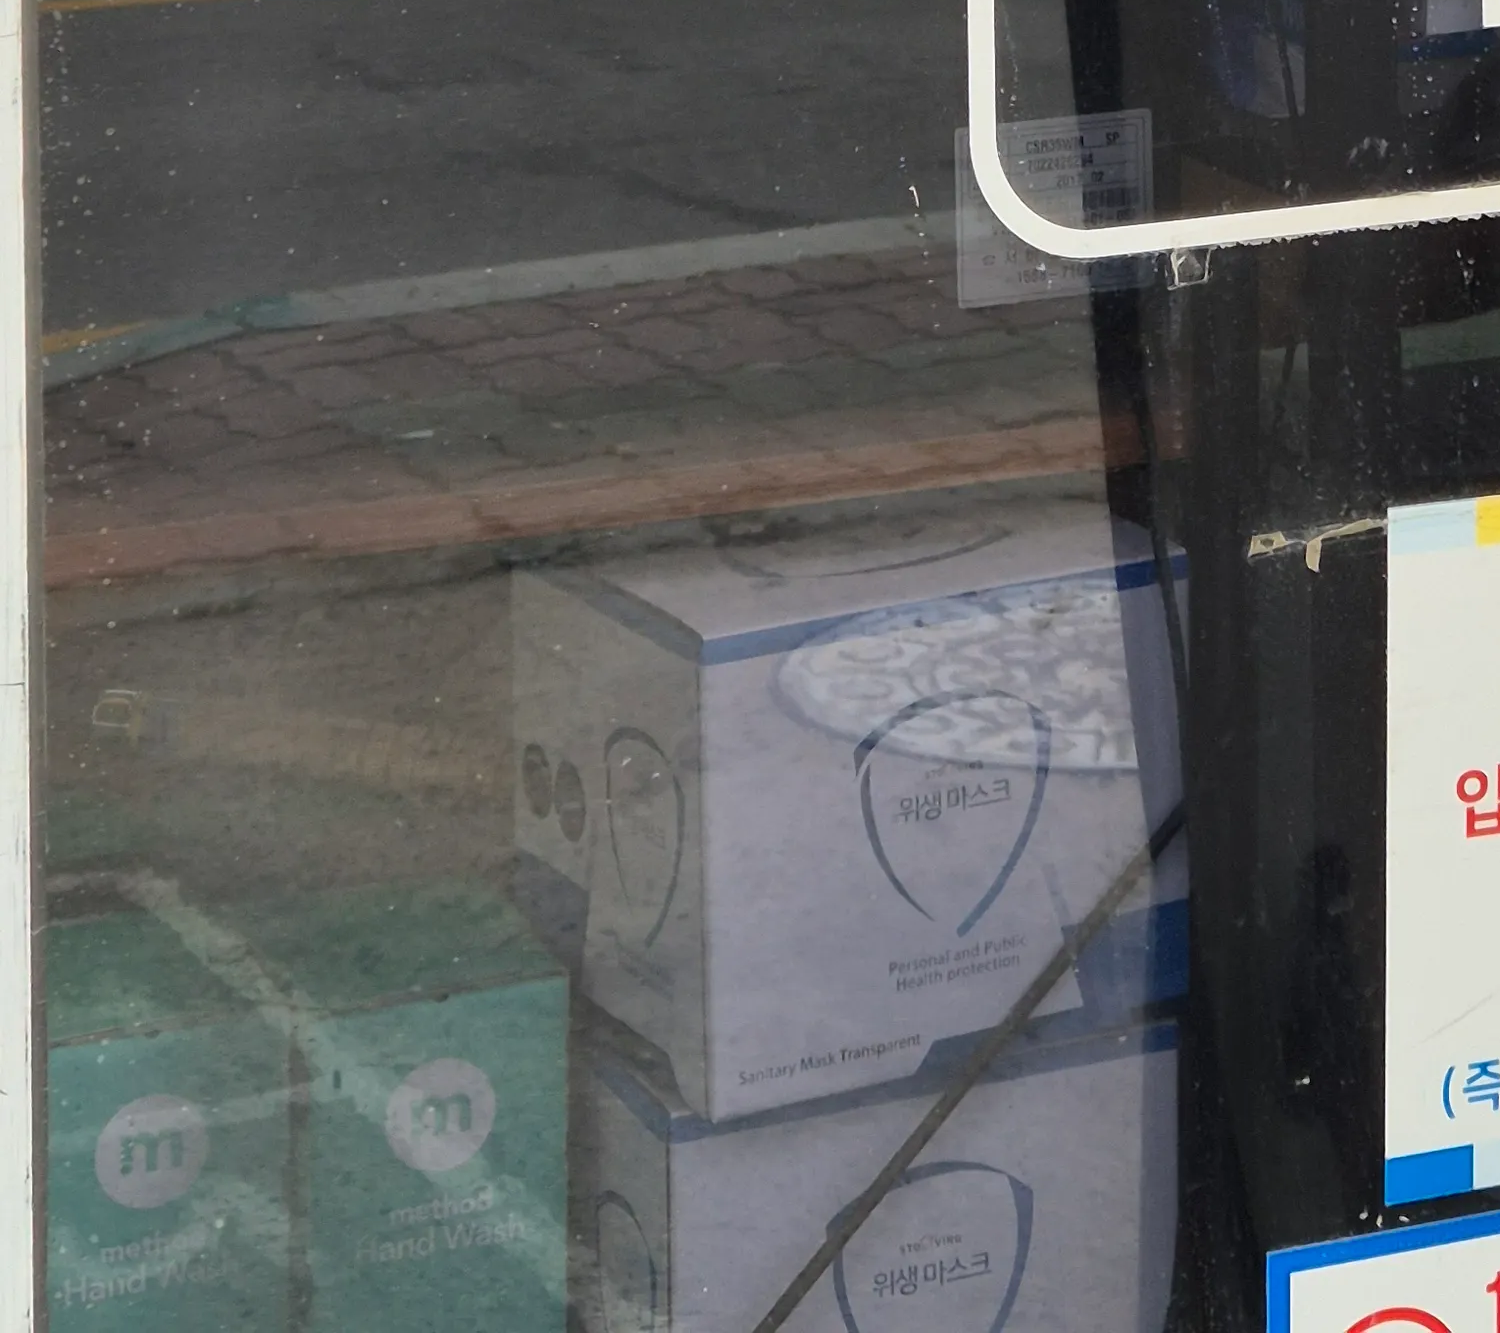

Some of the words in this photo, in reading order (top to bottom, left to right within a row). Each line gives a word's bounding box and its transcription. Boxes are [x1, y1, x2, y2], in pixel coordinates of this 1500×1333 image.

[800, 1052, 837, 1072] Mask
[839, 1033, 921, 1063] Transparent
[872, 1251, 992, 1298] 위생마스크
